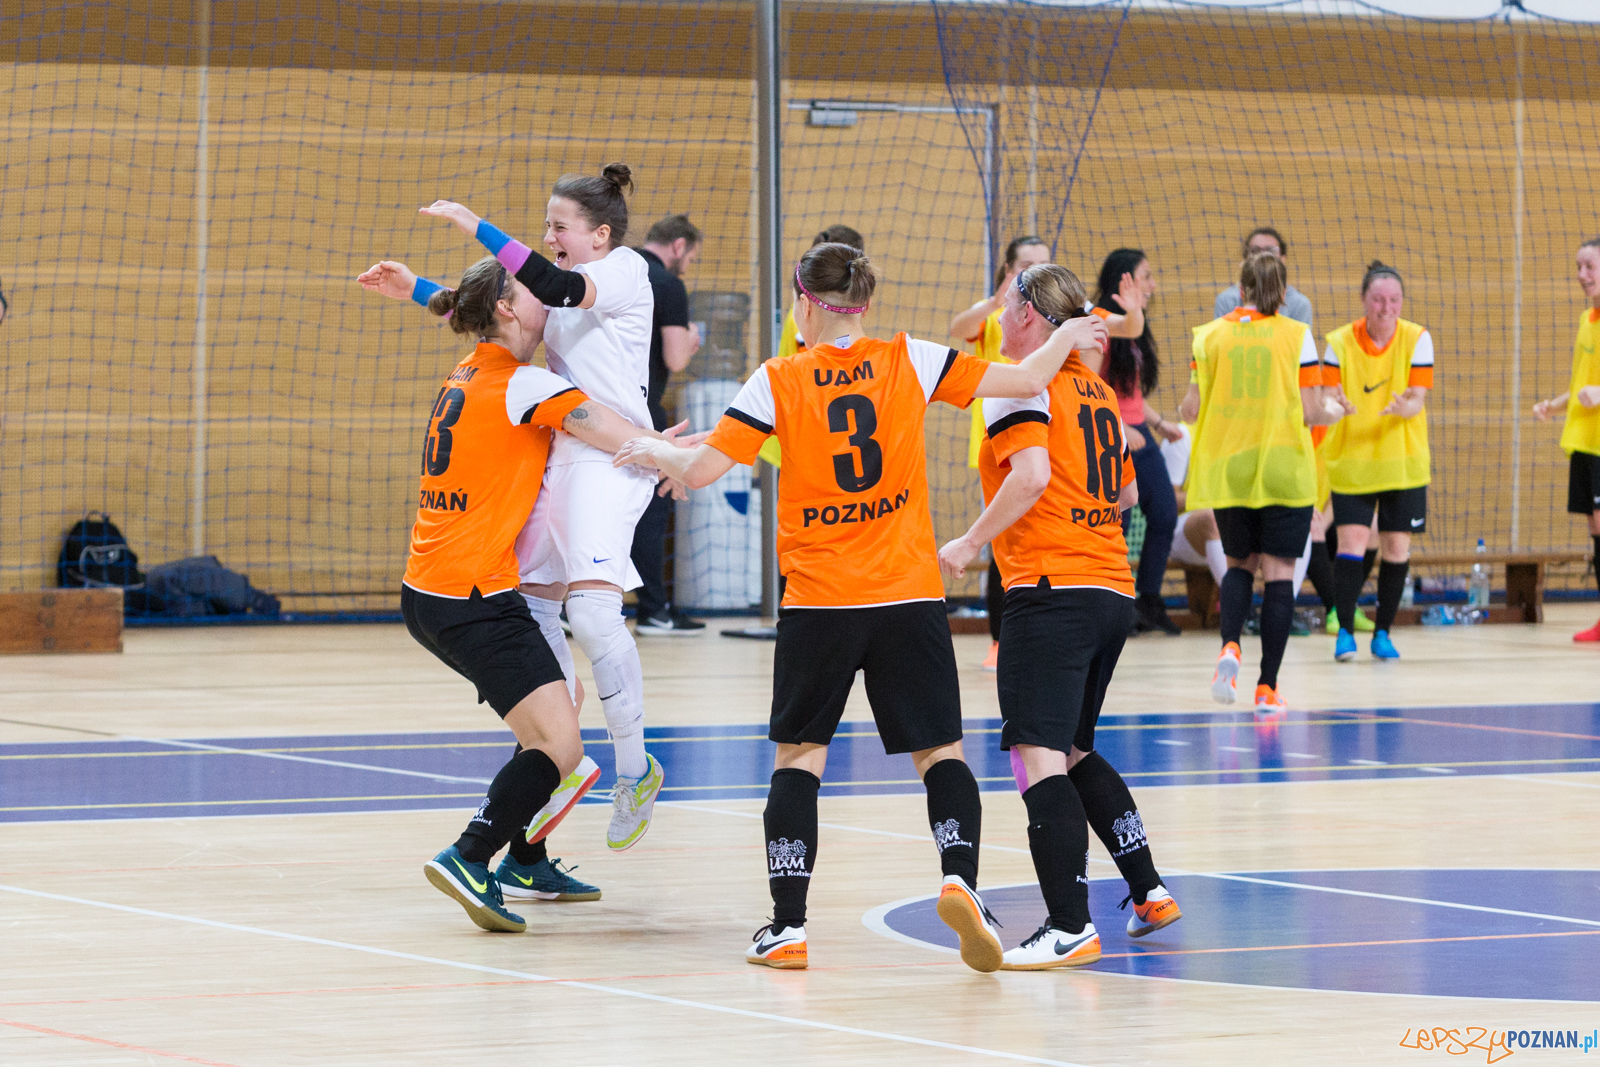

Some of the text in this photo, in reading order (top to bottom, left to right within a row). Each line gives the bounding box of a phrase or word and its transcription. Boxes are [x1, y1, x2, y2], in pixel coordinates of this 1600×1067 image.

[813, 360, 875, 387] UAM
[1227, 345, 1272, 399] 19
[1073, 378, 1109, 401] UAM
[421, 386, 466, 477] 13
[827, 394, 883, 493] 3
[1077, 403, 1123, 503] 18
[419, 488, 468, 512] ZNAŃ
[770, 857, 806, 870] UAM
[787, 870, 812, 878] Kobie
